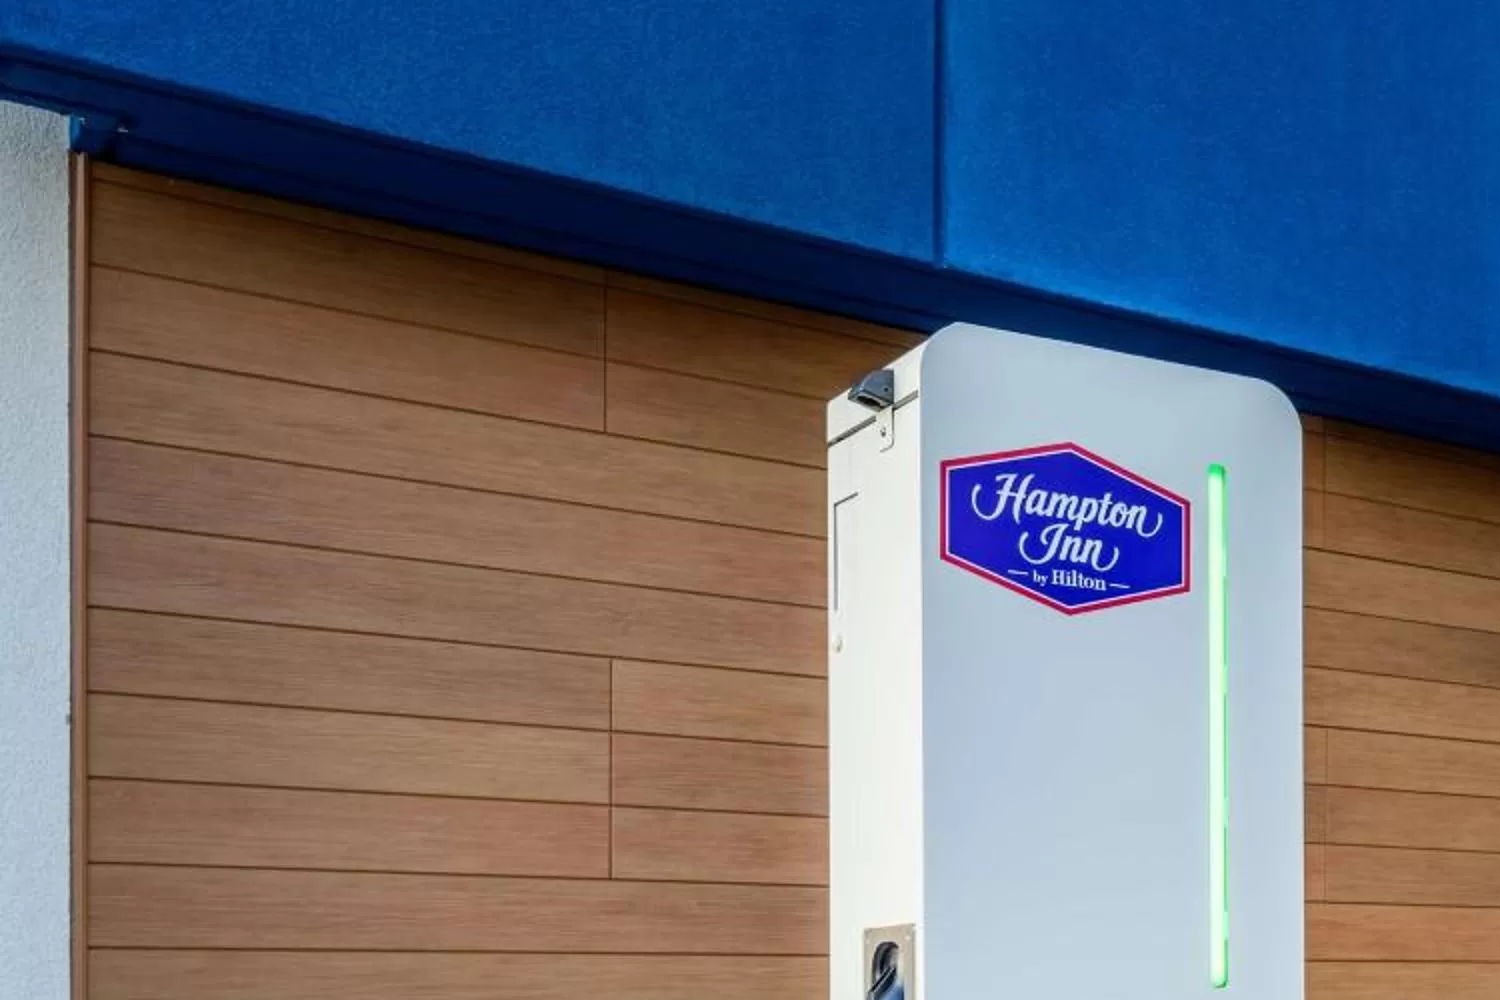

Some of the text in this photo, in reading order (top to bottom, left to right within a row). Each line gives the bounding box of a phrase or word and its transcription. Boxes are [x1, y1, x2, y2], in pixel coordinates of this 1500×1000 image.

[972, 474, 1163, 537] Hampton
[1019, 523, 1120, 572] Inn
[1033, 569, 1107, 591] by Hilton
